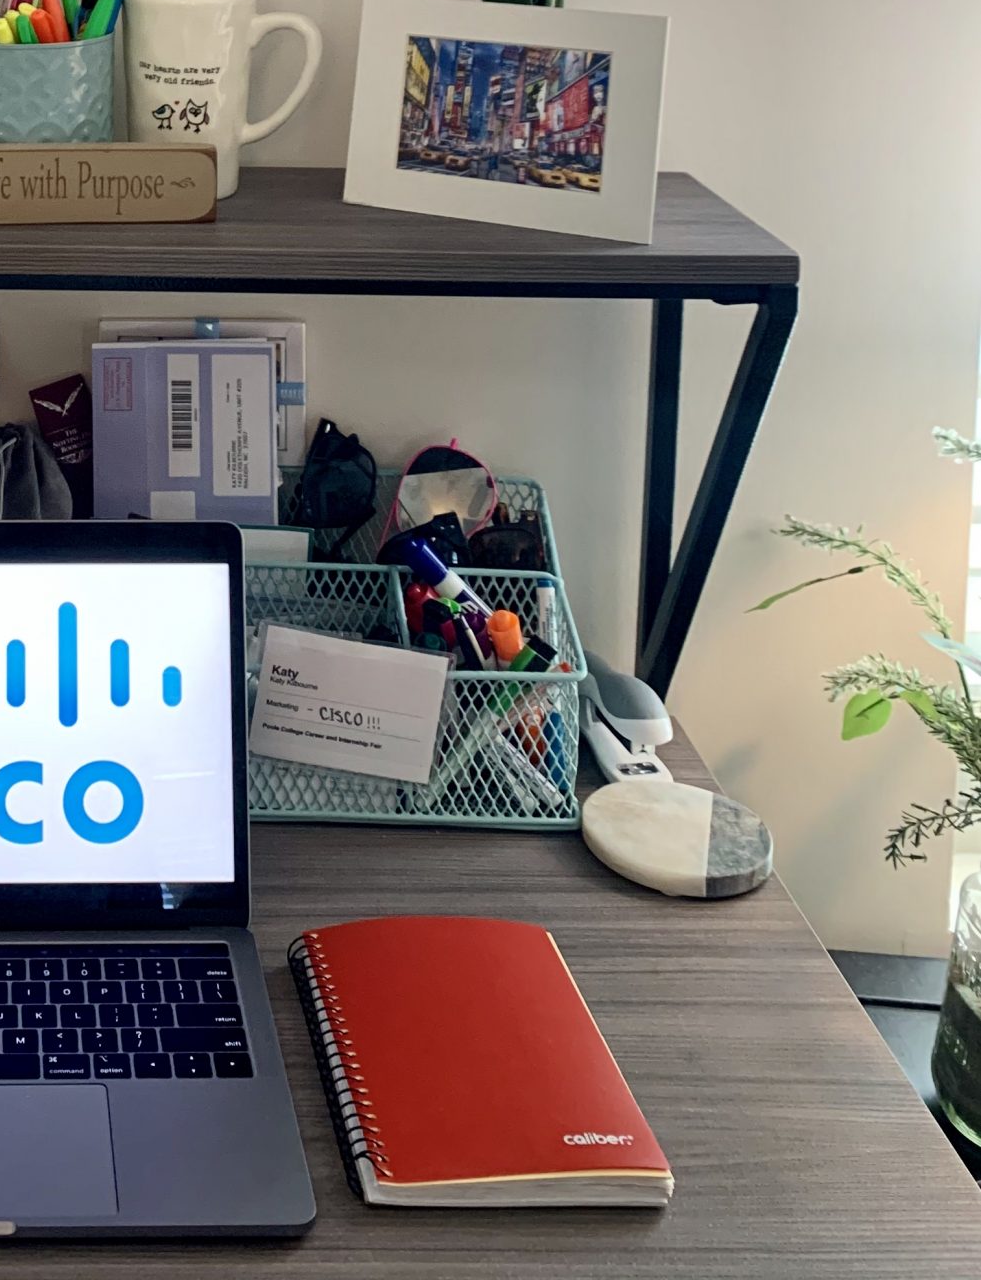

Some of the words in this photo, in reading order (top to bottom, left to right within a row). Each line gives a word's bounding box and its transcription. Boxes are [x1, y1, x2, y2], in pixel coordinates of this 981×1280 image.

[153, 64, 181, 75] hearts
[201, 66, 221, 74] very
[144, 73, 162, 83] very
[163, 77, 178, 85] old
[180, 78, 216, 86] friends.
[19, 157, 68, 200] with
[77, 160, 165, 215] Purpose
[271, 664, 300, 681] Katy
[270, 676, 285, 686] Katy
[266, 698, 299, 712] Marketing
[319, 706, 364, 727] CISCO
[262, 722, 280, 733] Poole
[280, 726, 304, 737] College
[305, 730, 325, 740] Career
[325, 734, 338, 742] and
[338, 736, 369, 748] Internship
[369, 742, 382, 750] Fair
[100, 1067, 123, 1075] option
[563, 1132, 625, 1146] caliber
